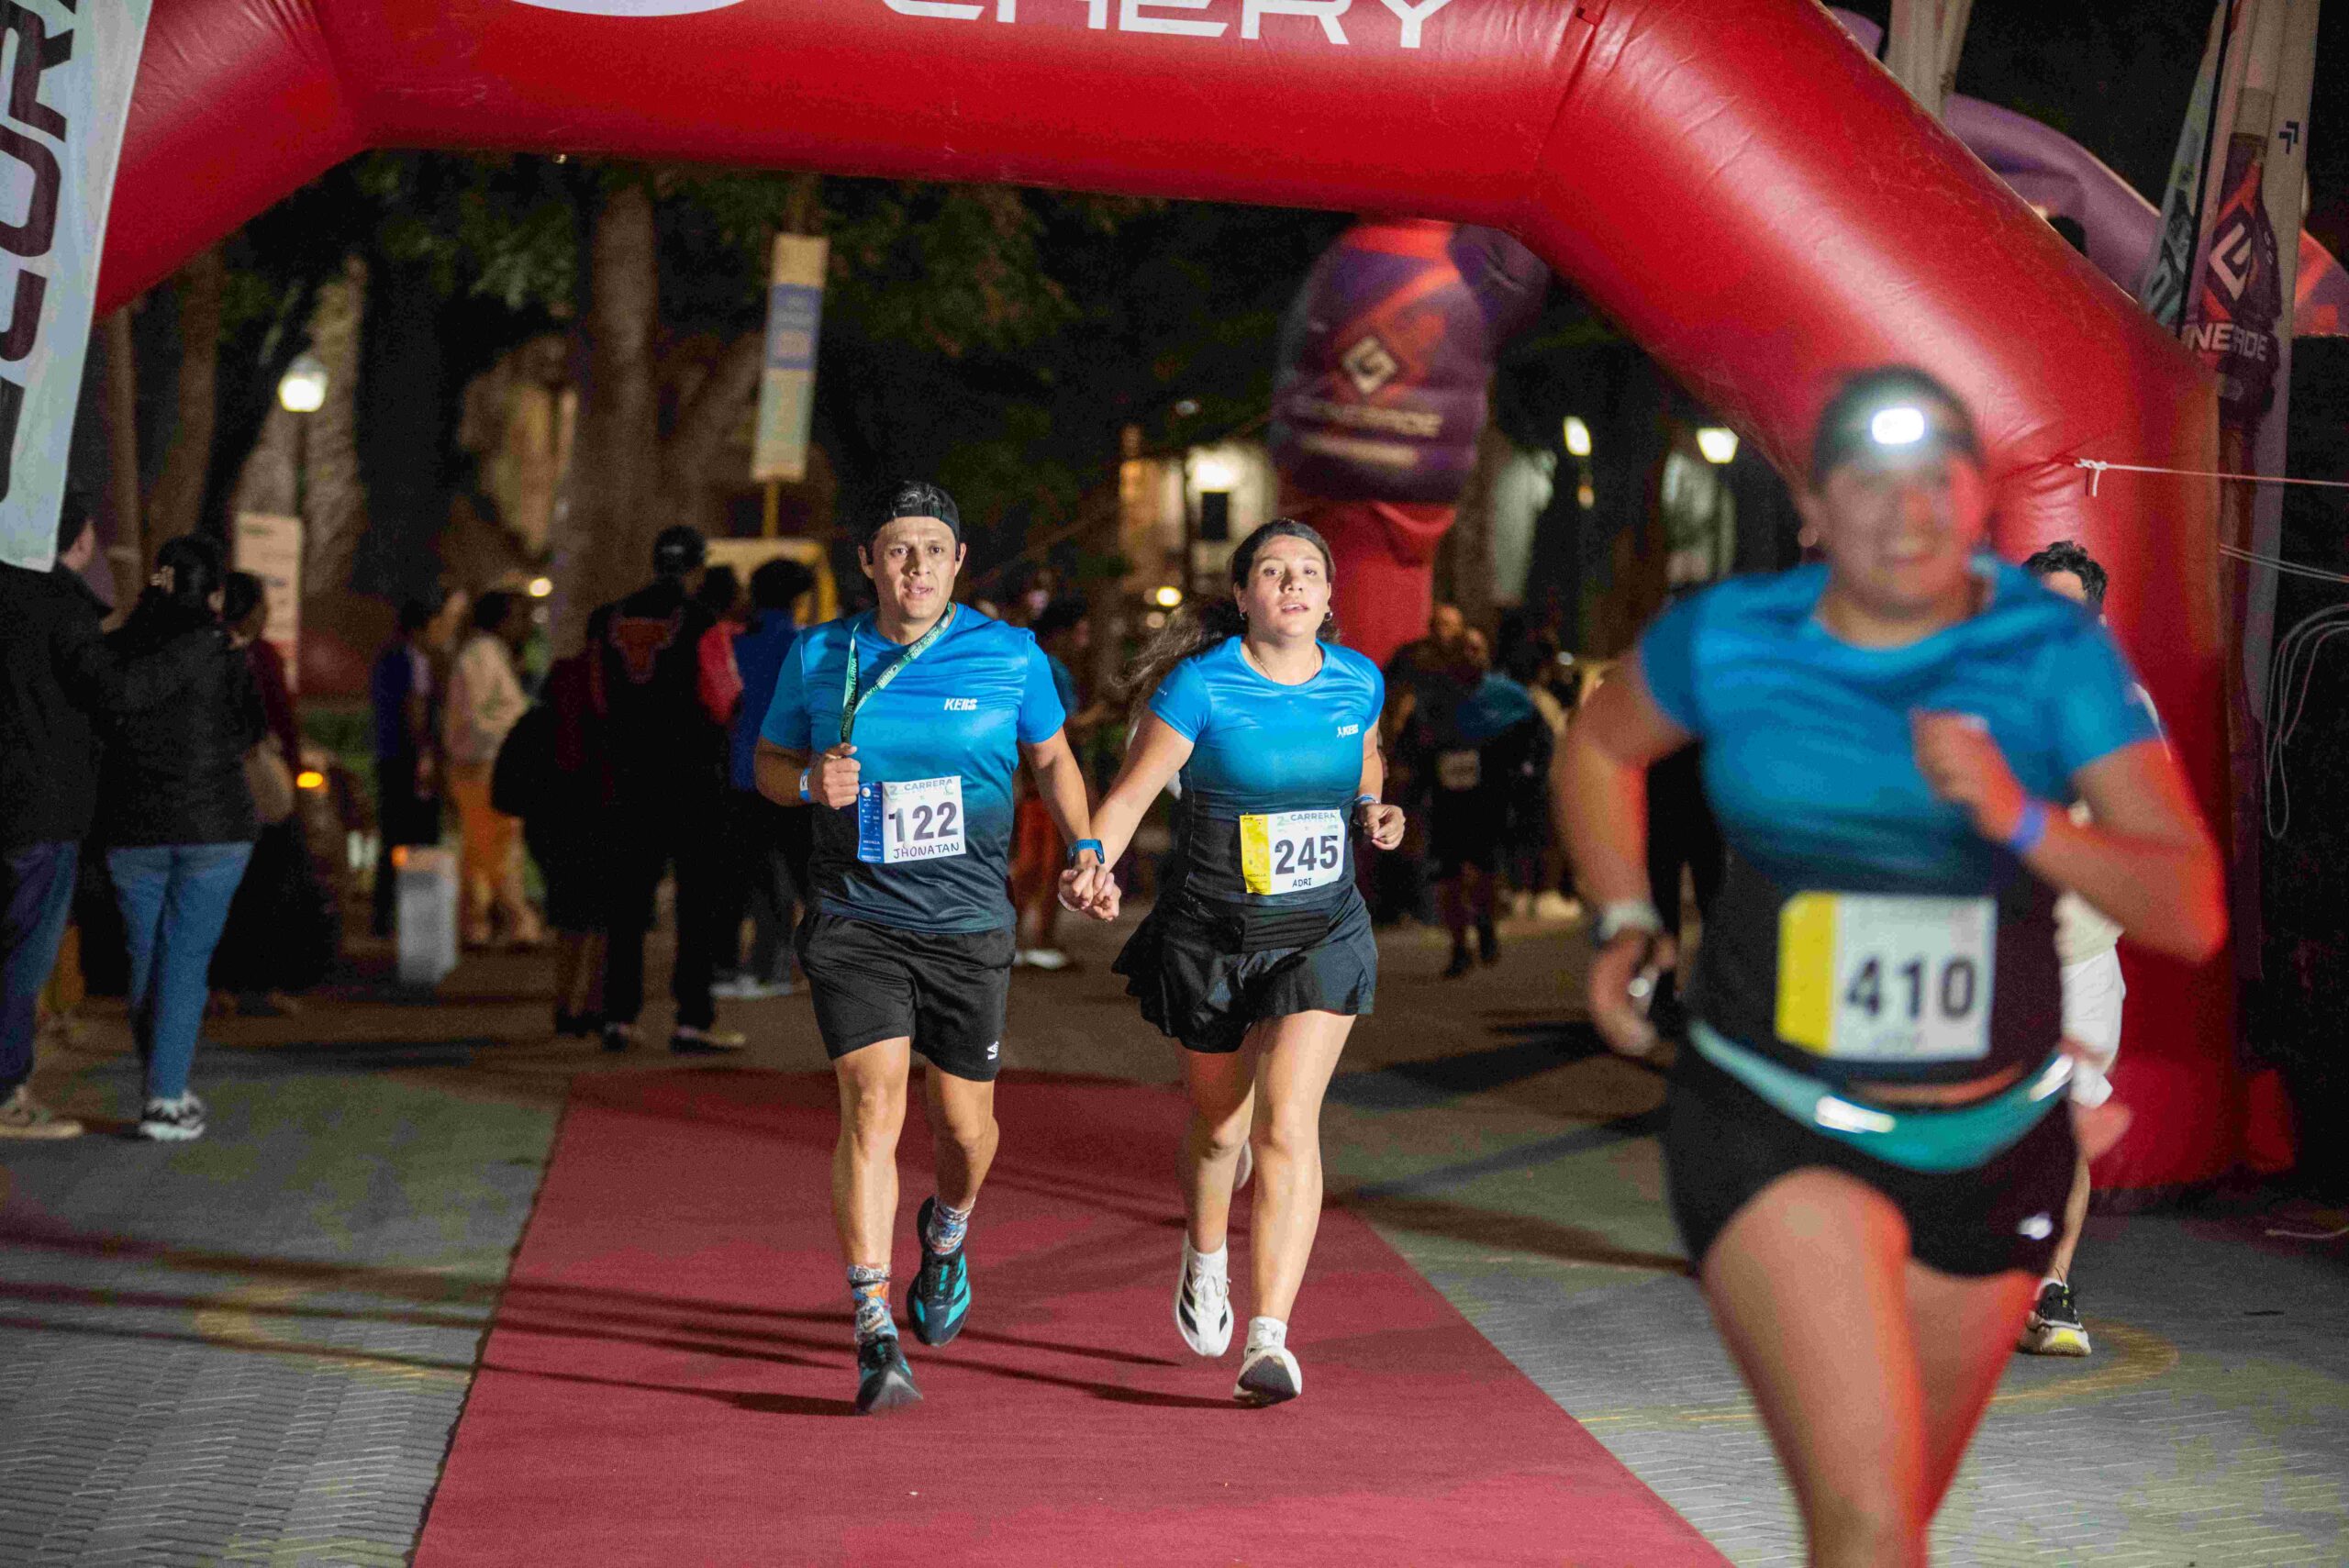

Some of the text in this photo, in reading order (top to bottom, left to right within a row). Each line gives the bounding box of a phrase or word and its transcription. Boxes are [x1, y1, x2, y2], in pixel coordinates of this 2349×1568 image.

[943, 697, 978, 711] KERS
[904, 778, 952, 791] CARRERA
[888, 801, 958, 843] 122
[1290, 812, 1337, 822] CARRERA
[894, 842, 960, 859] JHONATAN
[1275, 835, 1339, 875] 245
[1292, 877, 1312, 888] ADRI
[1844, 954, 1977, 1021] 410
